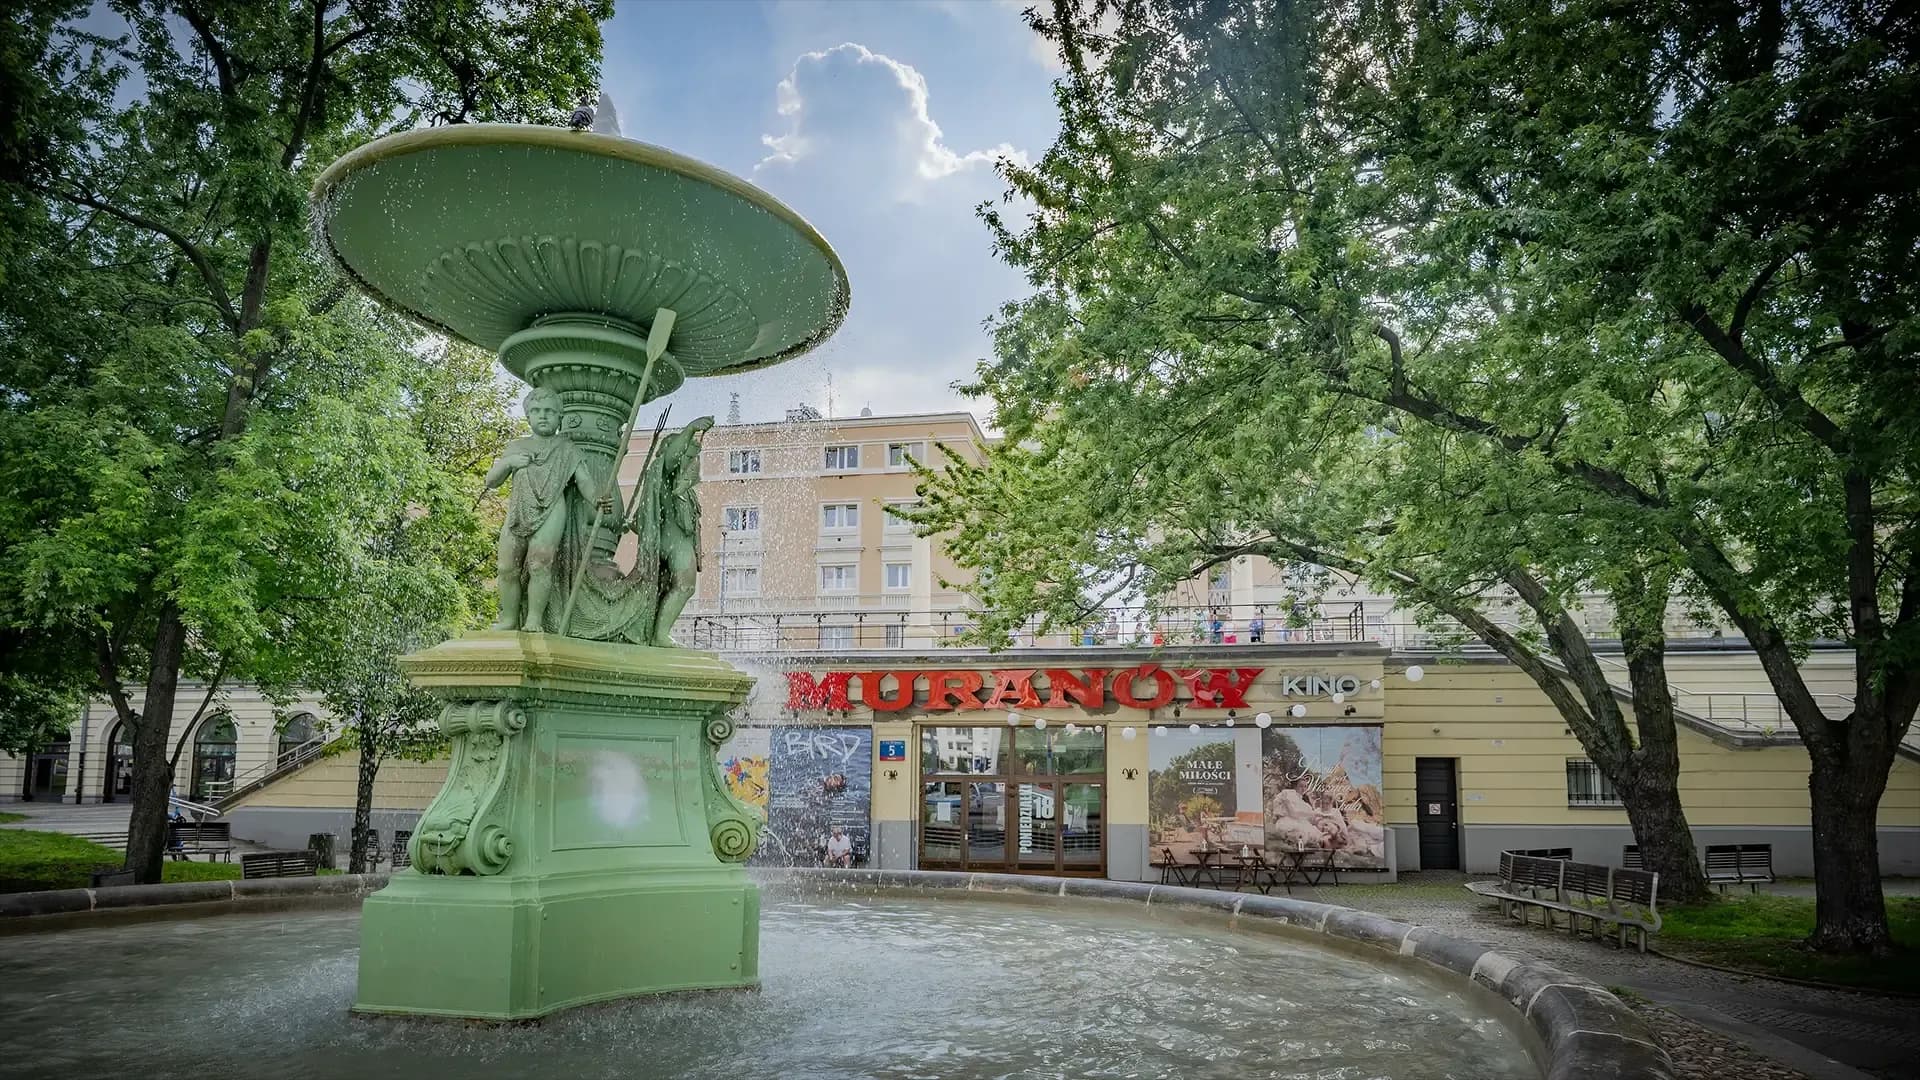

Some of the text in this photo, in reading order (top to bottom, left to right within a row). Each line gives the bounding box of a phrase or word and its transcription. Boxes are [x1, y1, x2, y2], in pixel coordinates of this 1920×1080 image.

[784, 664, 1264, 710] MURANÓW
[1282, 674, 1360, 697] KINO
[888, 745, 896, 756] 5
[1187, 760, 1223, 769] MAŁE
[1179, 769, 1231, 780] MIŁOŚCI
[1033, 797, 1055, 819] 18
